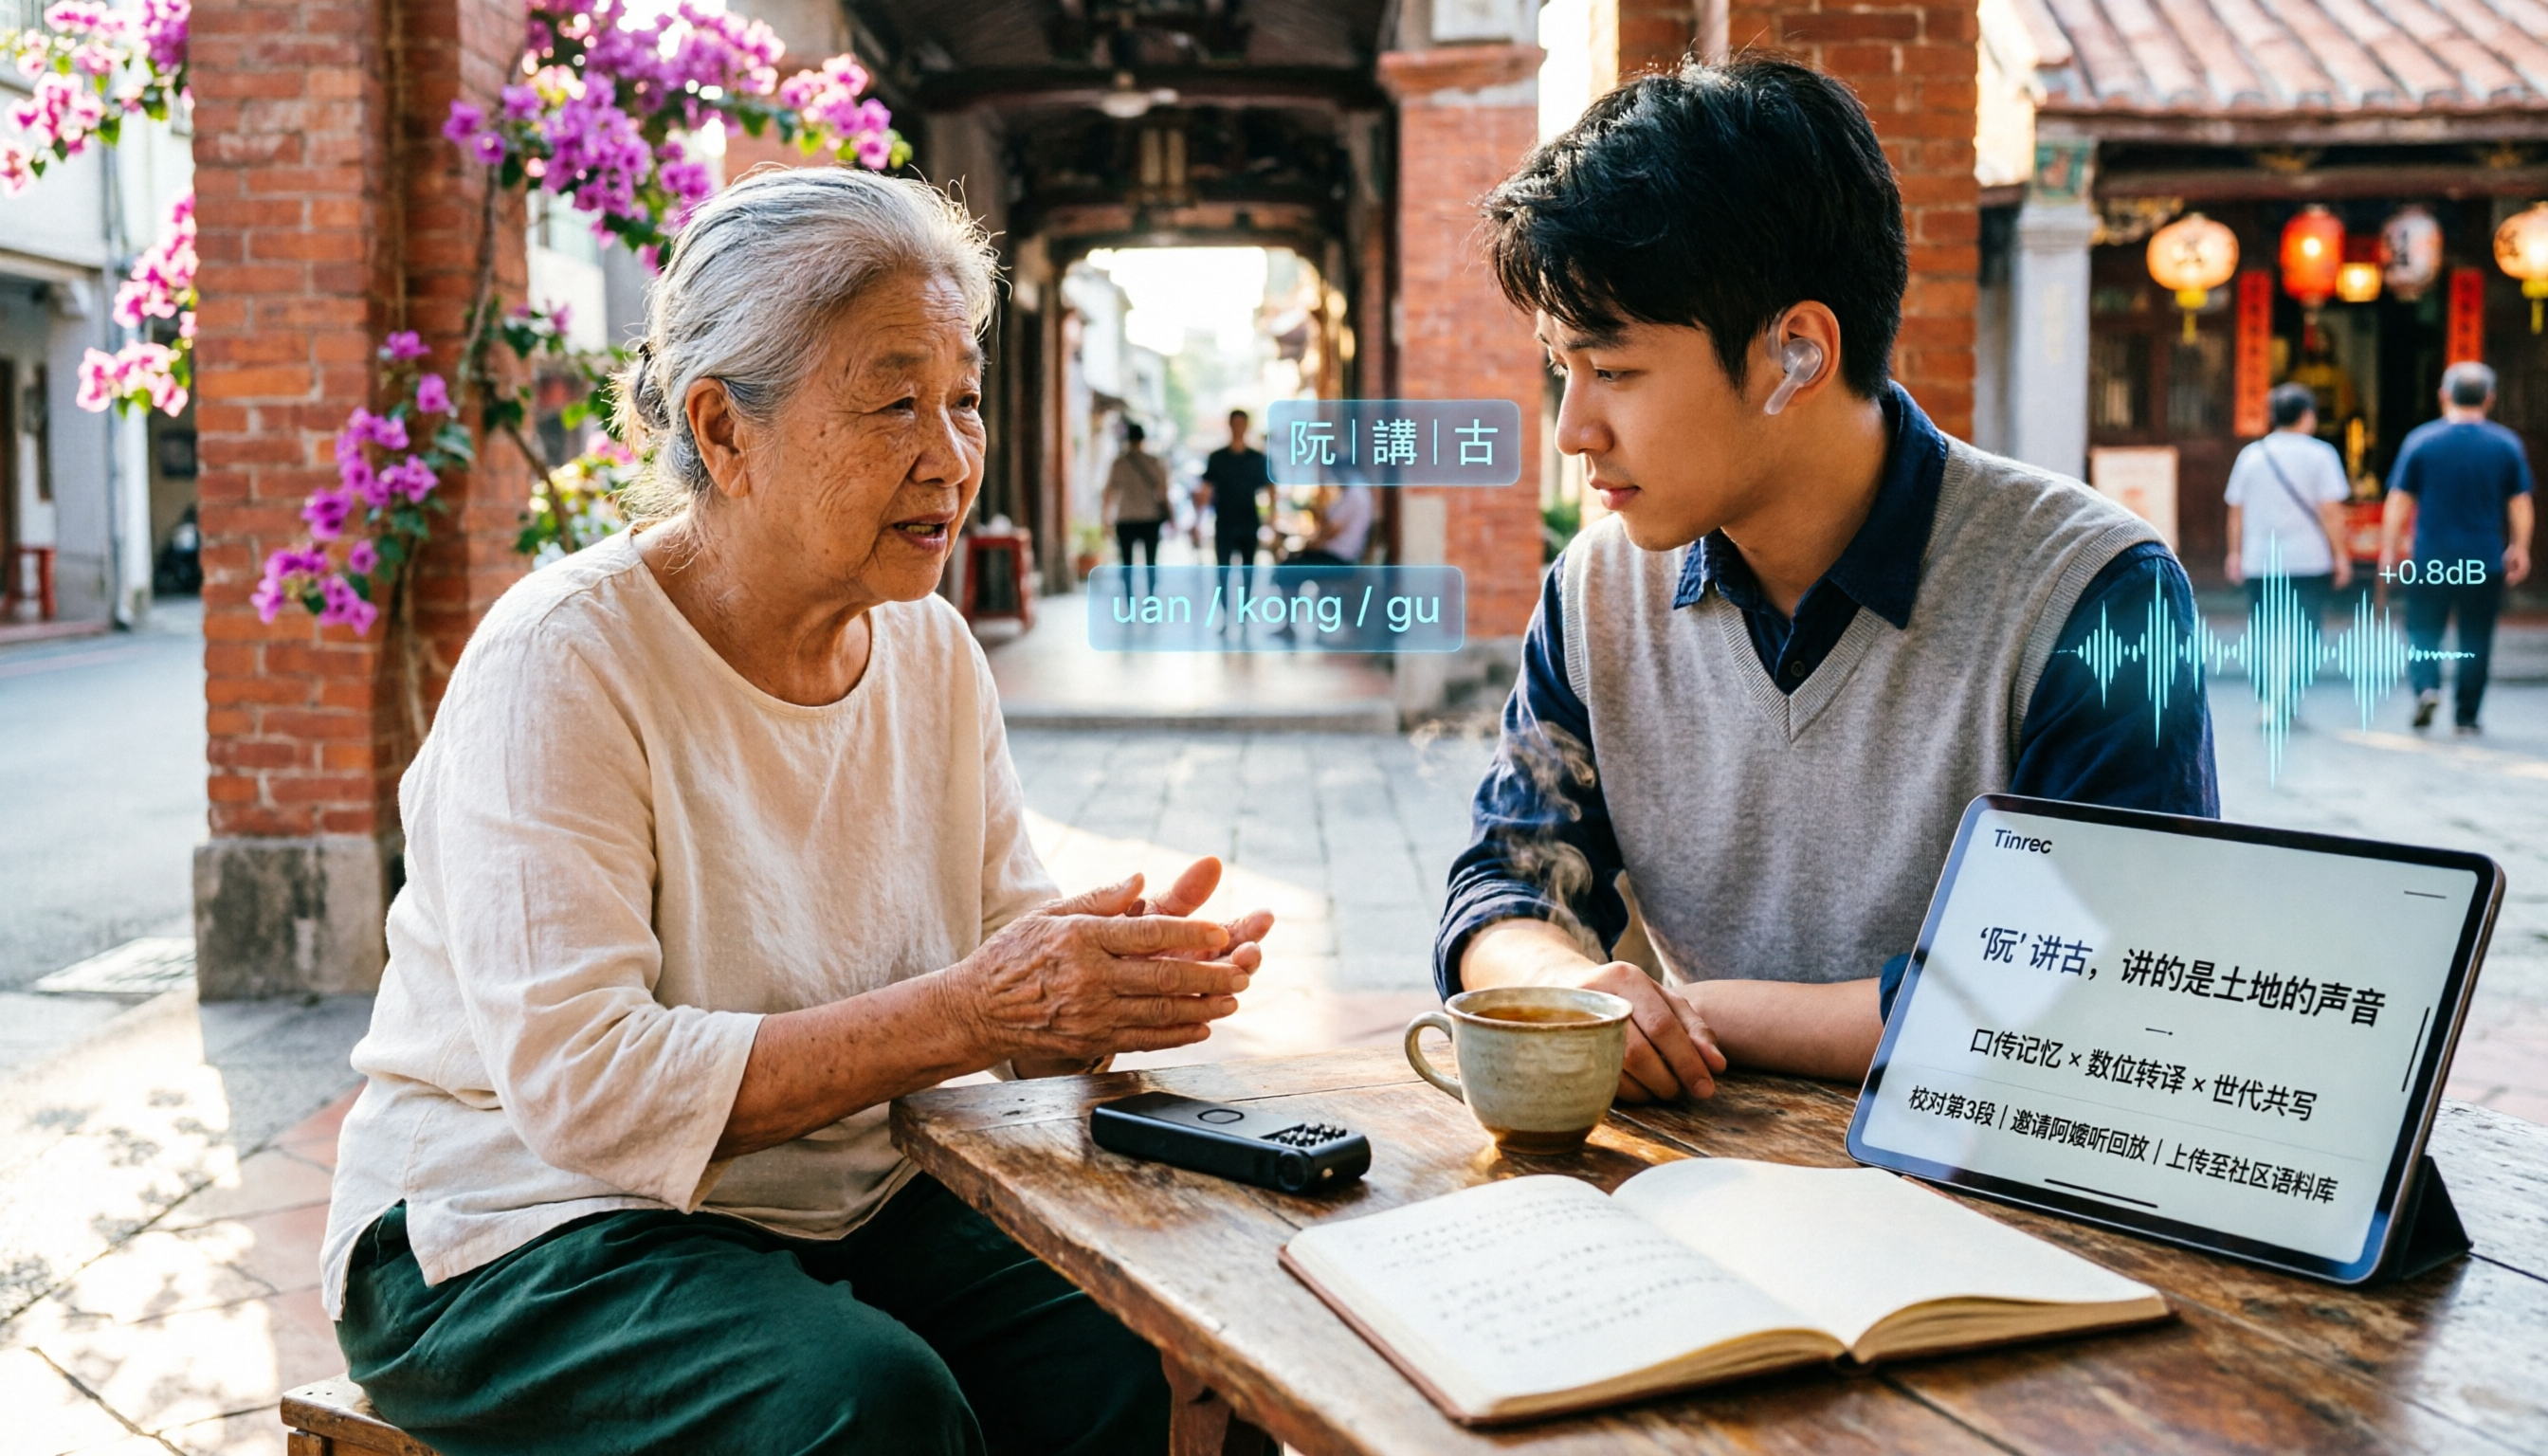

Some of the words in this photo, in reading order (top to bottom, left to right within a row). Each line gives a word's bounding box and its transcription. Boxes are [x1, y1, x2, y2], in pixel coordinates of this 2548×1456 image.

[1994, 828, 2053, 855] Tinrec
[1970, 1028, 2065, 1069] 口传记忆
[2084, 1047, 2187, 1095] 数位转译
[2212, 1073, 2318, 1122] 世代共写
[1908, 1085, 1996, 1127] 校对第3段
[2164, 1142, 2339, 1205] 上传至社区语料库
